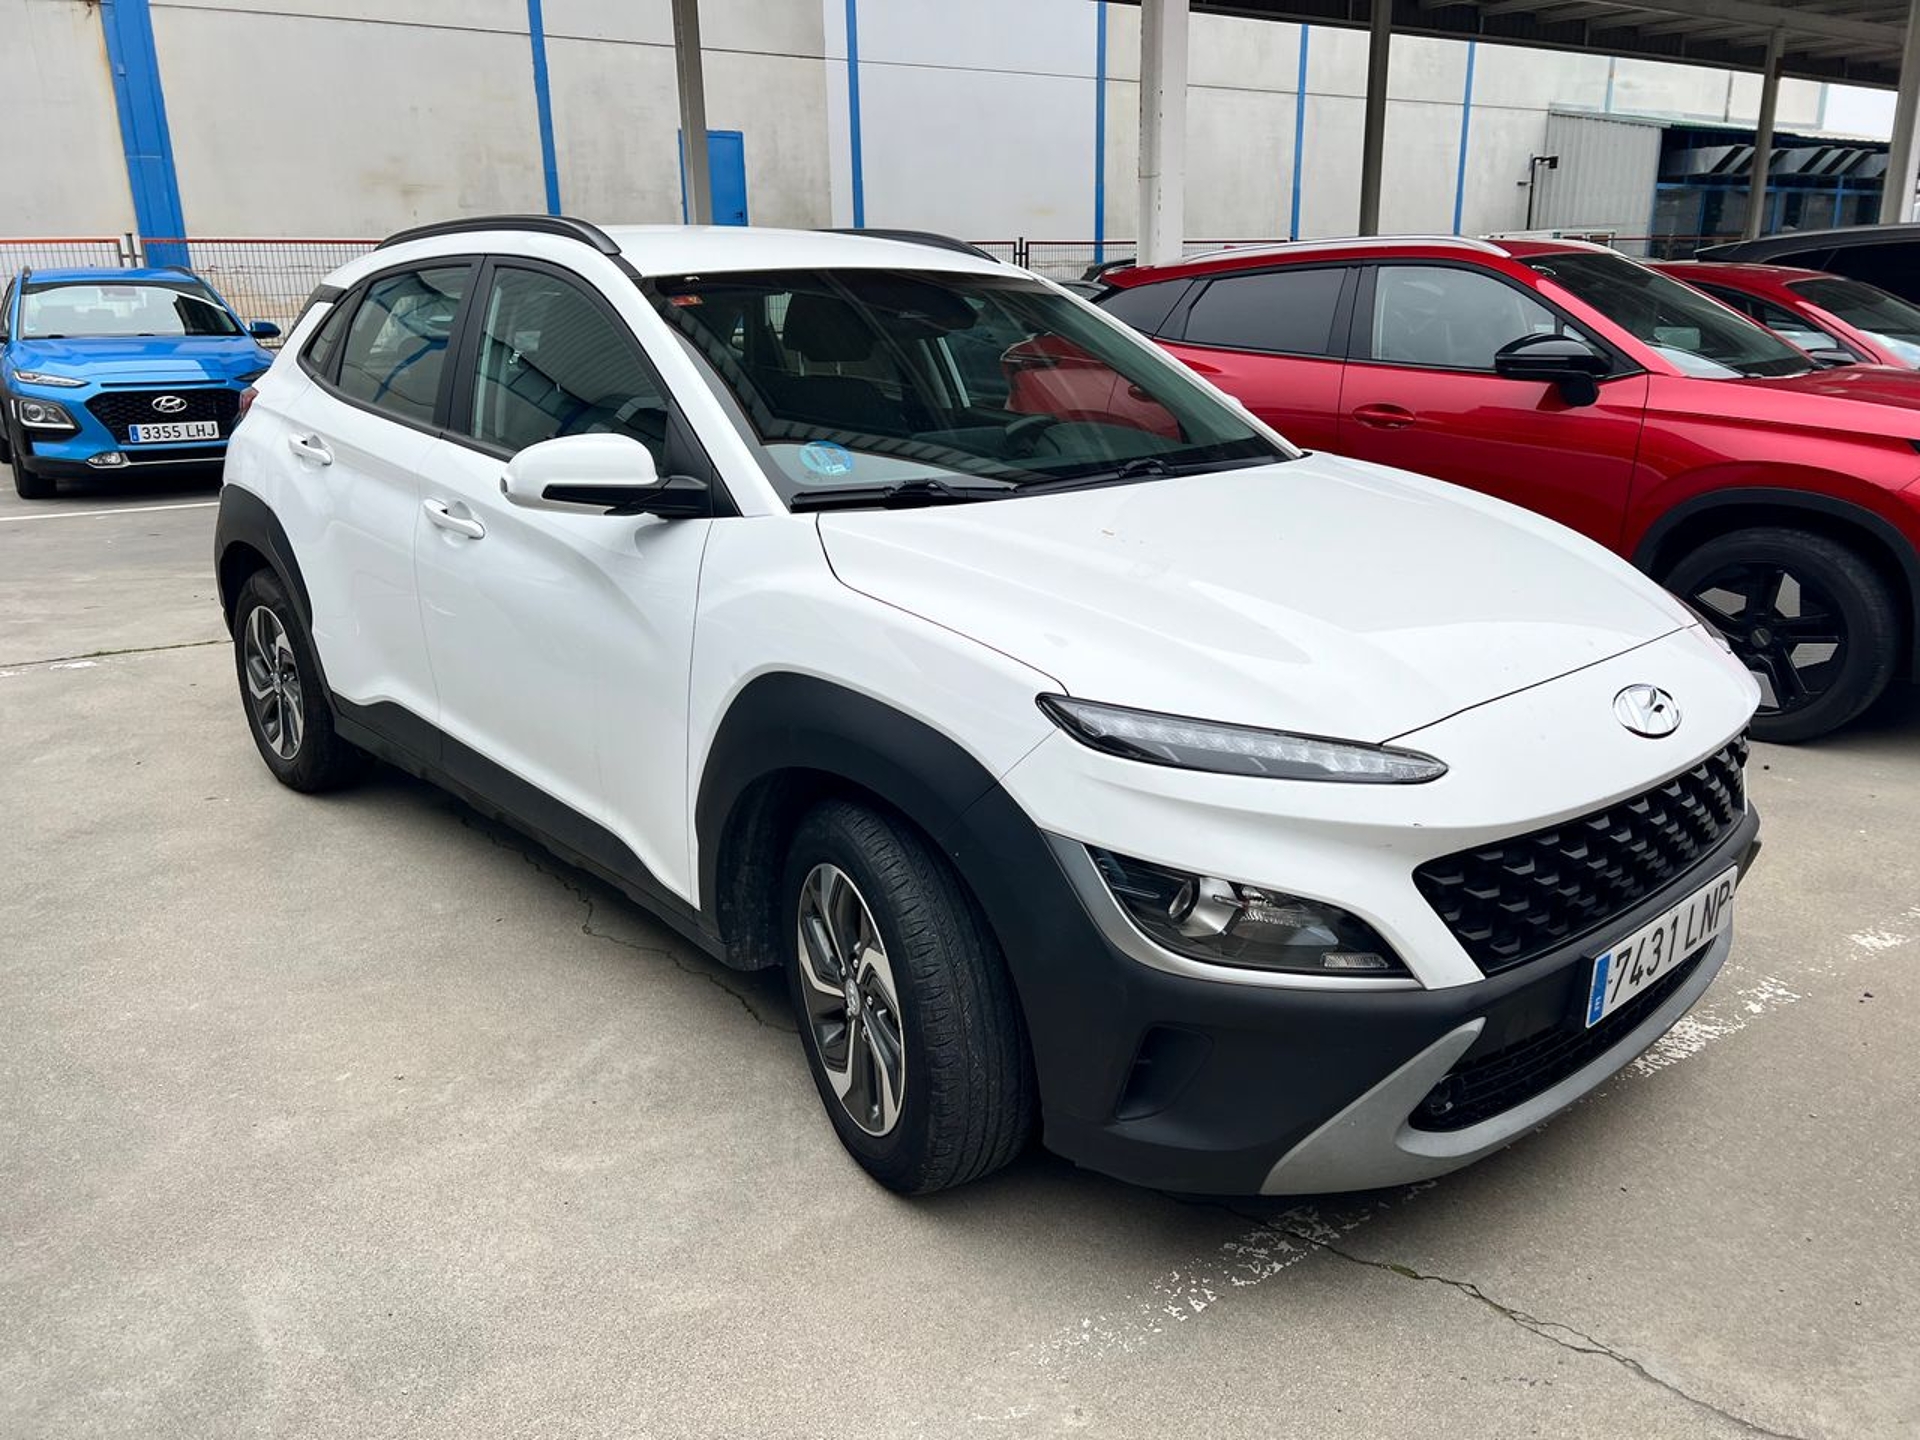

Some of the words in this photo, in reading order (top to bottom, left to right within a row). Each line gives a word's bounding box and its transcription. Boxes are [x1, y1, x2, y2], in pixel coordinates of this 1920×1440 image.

[141, 425, 182, 440] 3355
[185, 423, 216, 438] LHJ
[1610, 914, 1679, 1004] 7431
[1684, 879, 1731, 951] LNP
